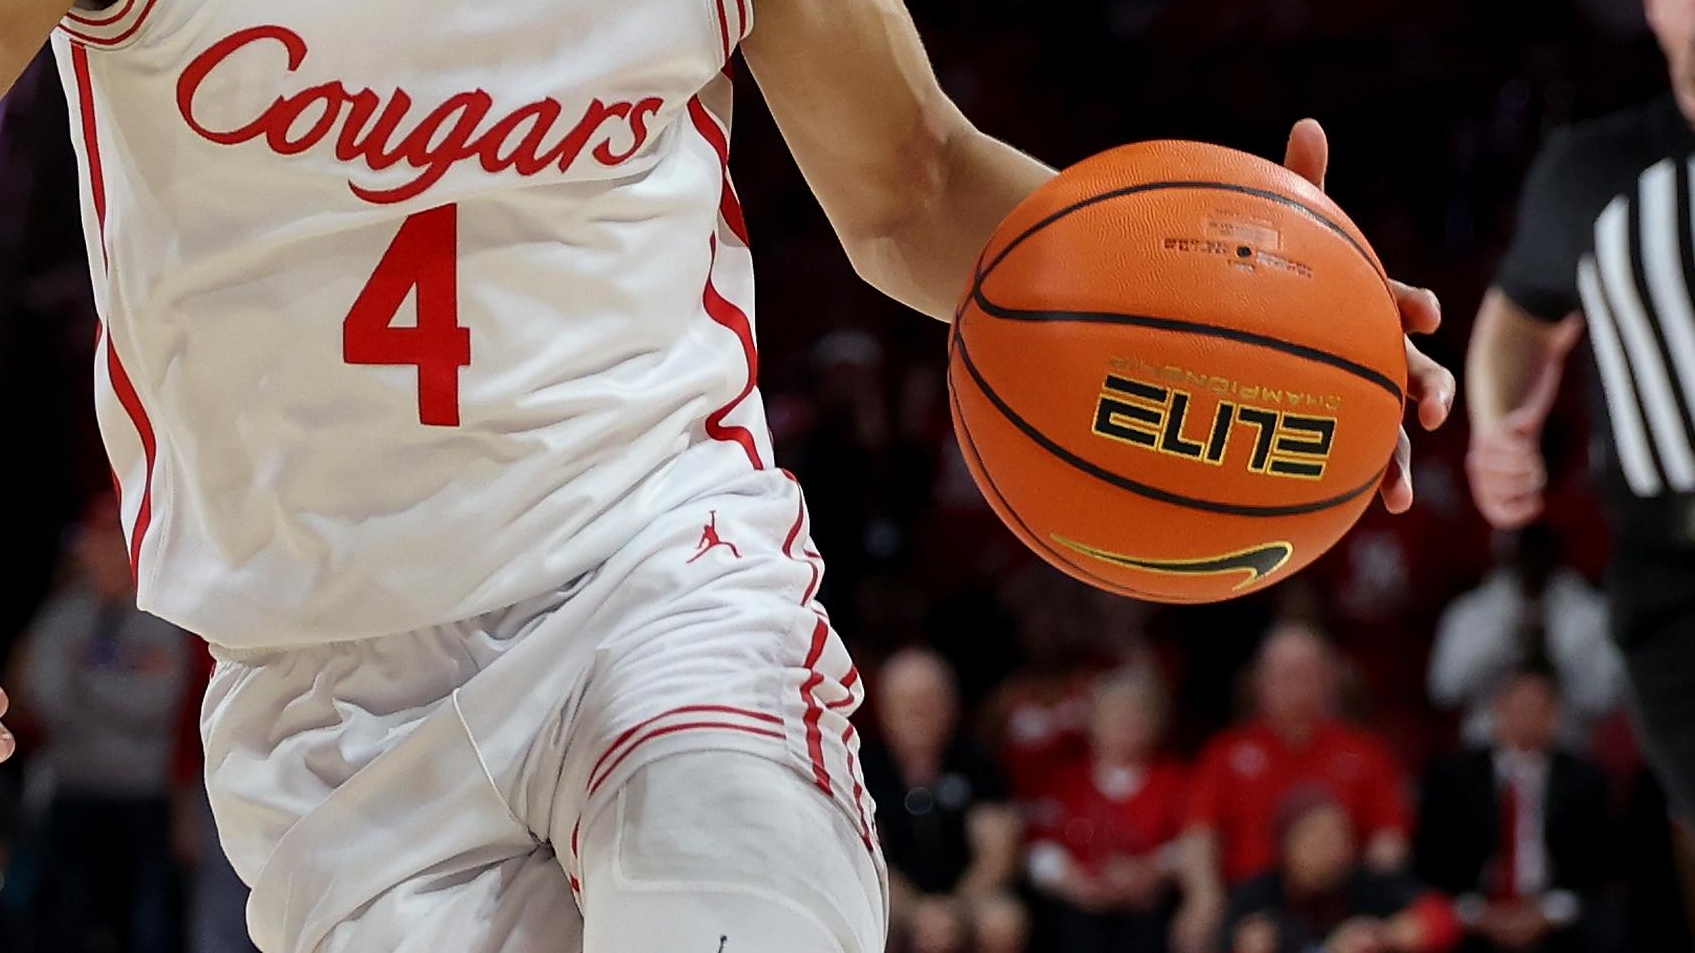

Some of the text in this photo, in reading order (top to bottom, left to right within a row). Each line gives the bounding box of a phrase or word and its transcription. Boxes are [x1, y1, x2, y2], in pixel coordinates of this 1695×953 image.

[175, 24, 665, 205] Cougars
[342, 202, 472, 427] 4
[1091, 373, 1338, 482] ELITE
